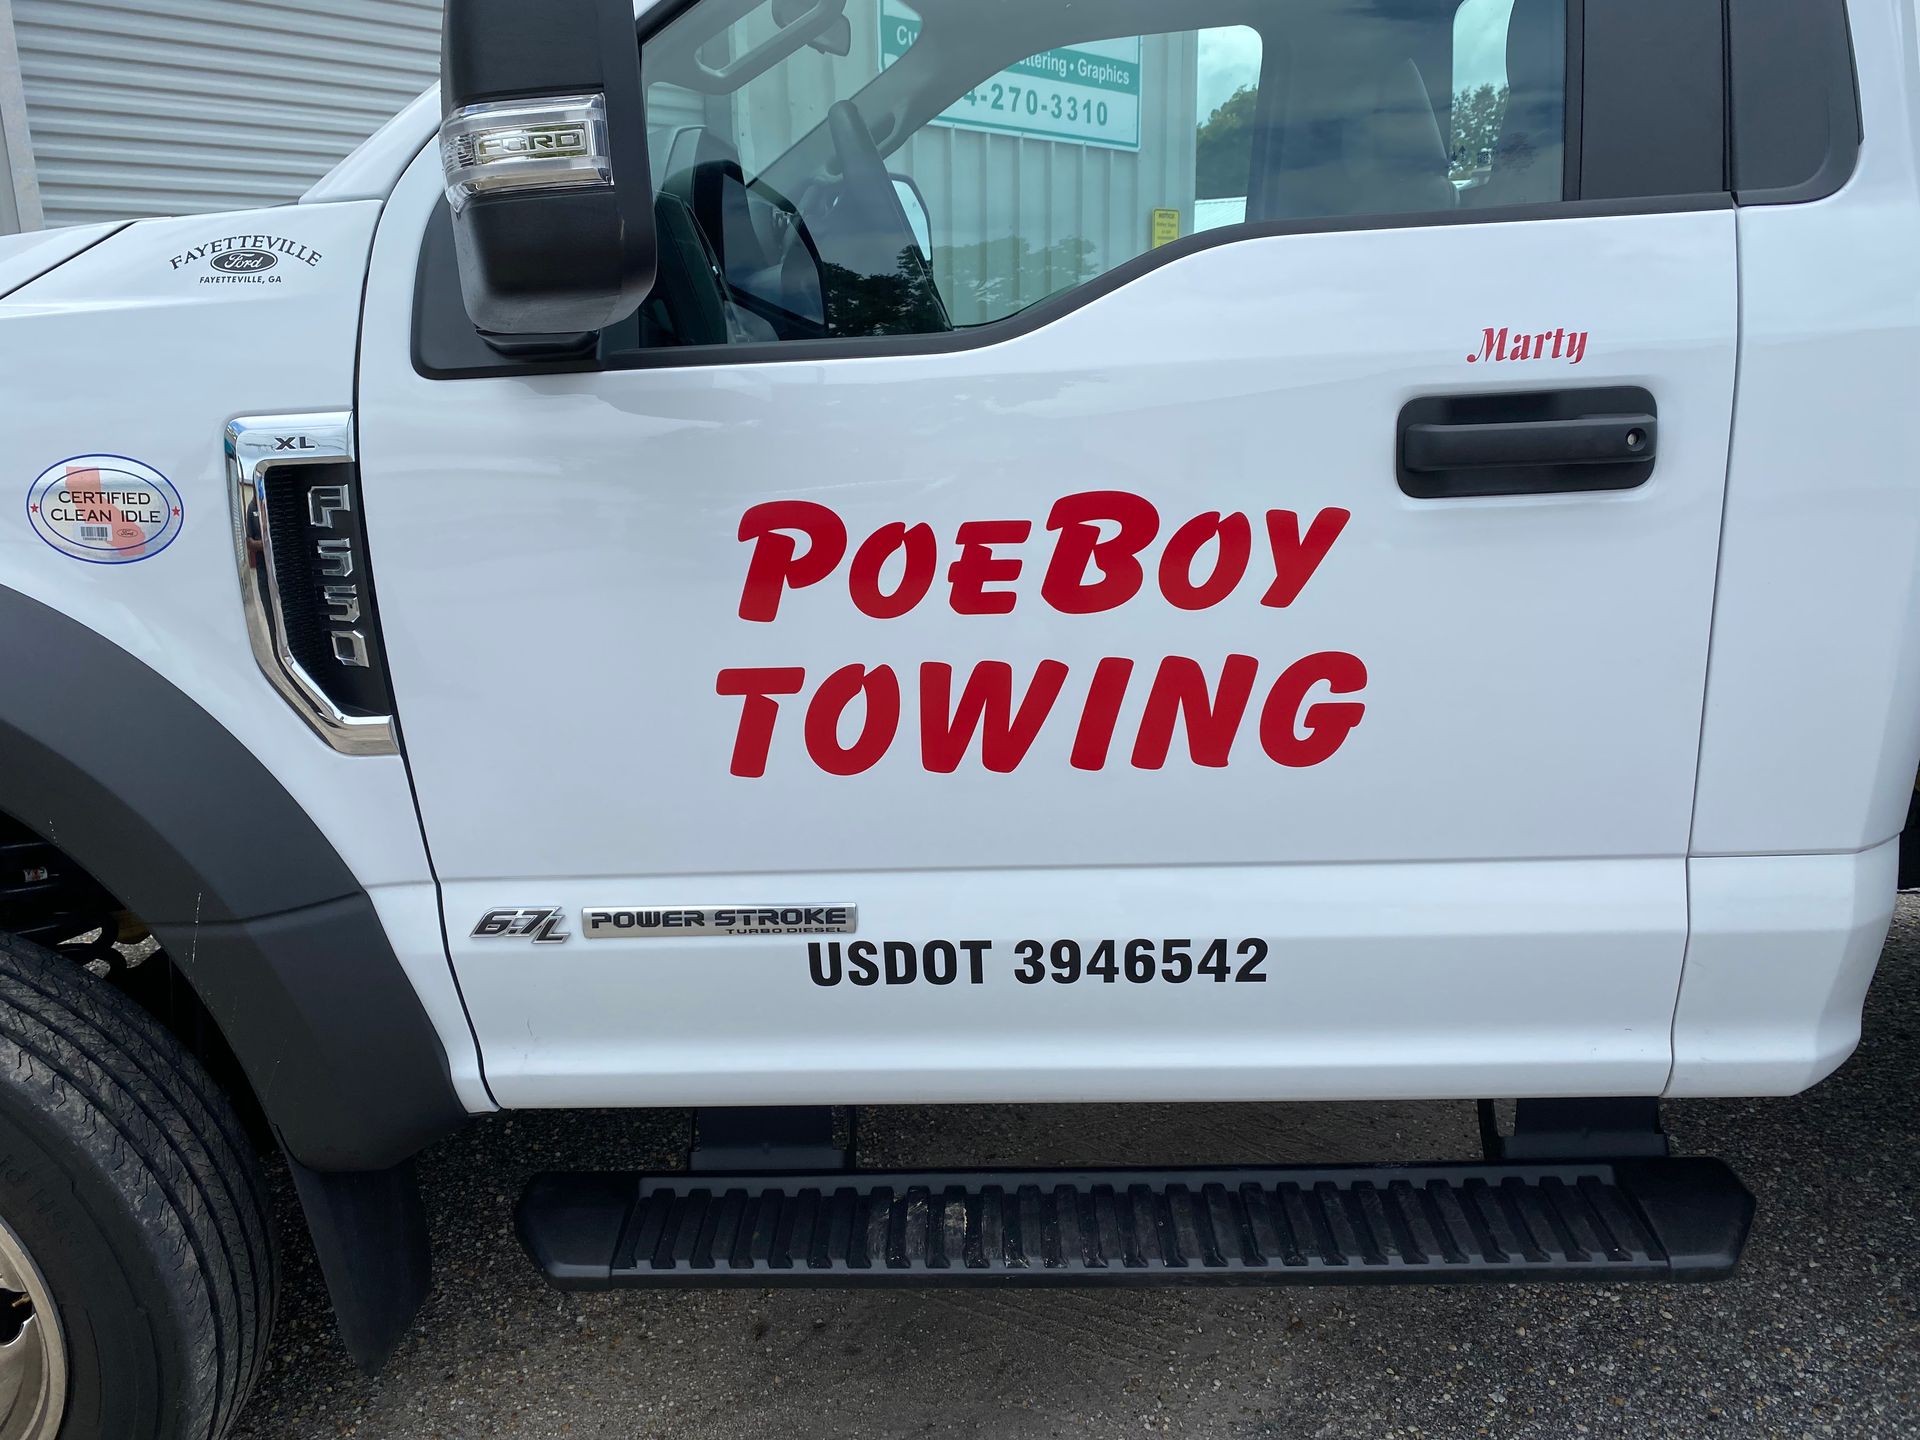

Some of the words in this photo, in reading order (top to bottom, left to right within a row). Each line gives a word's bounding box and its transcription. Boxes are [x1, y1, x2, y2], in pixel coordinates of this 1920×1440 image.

[1077, 58, 1130, 84] Graphics
[477, 128, 587, 158] FORD
[169, 235, 323, 270] FAYETTEVILLE
[199, 275, 265, 284] FAYETTEVILLE,
[268, 275, 282, 283] GA
[1466, 327, 1588, 365] Marty
[274, 436, 316, 451] XL
[58, 490, 151, 505] CERTIFIED
[50, 508, 112, 522] CLEAN
[121, 510, 161, 523] IDLE
[716, 651, 1368, 778] TOWING
[470, 906, 571, 943] 6.7L
[591, 910, 705, 929] POWER
[714, 908, 847, 926] STROKE
[807, 940, 993, 987] USDOT
[1013, 938, 1269, 984] 3946542
